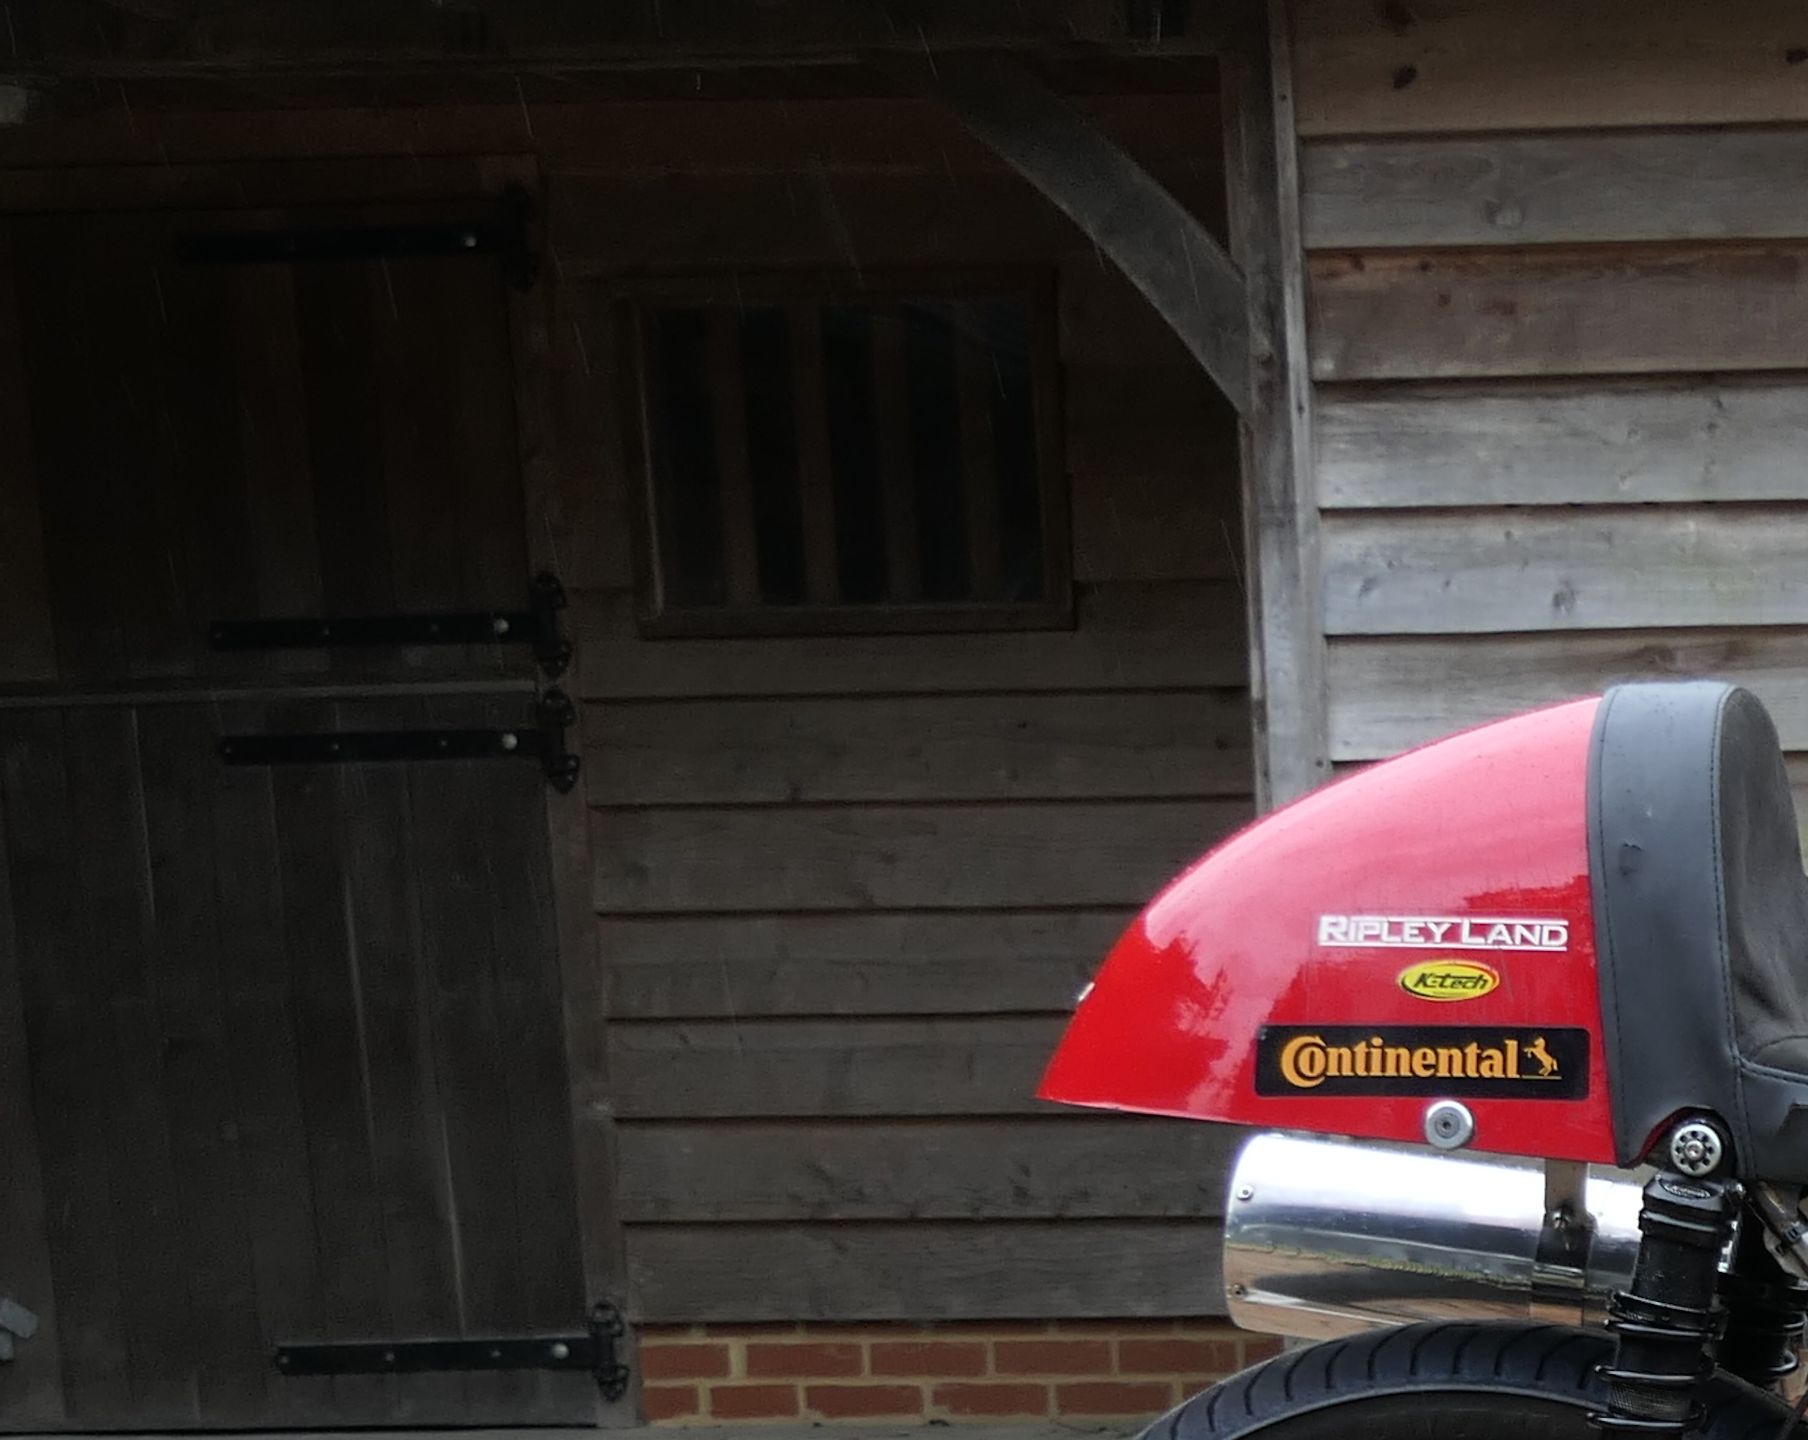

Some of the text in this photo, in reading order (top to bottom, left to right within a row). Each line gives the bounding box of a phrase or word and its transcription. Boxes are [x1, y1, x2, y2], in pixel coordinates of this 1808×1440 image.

[1318, 916, 1568, 947] RIPLEY LAND
[1281, 1035, 1519, 1088] Continental
